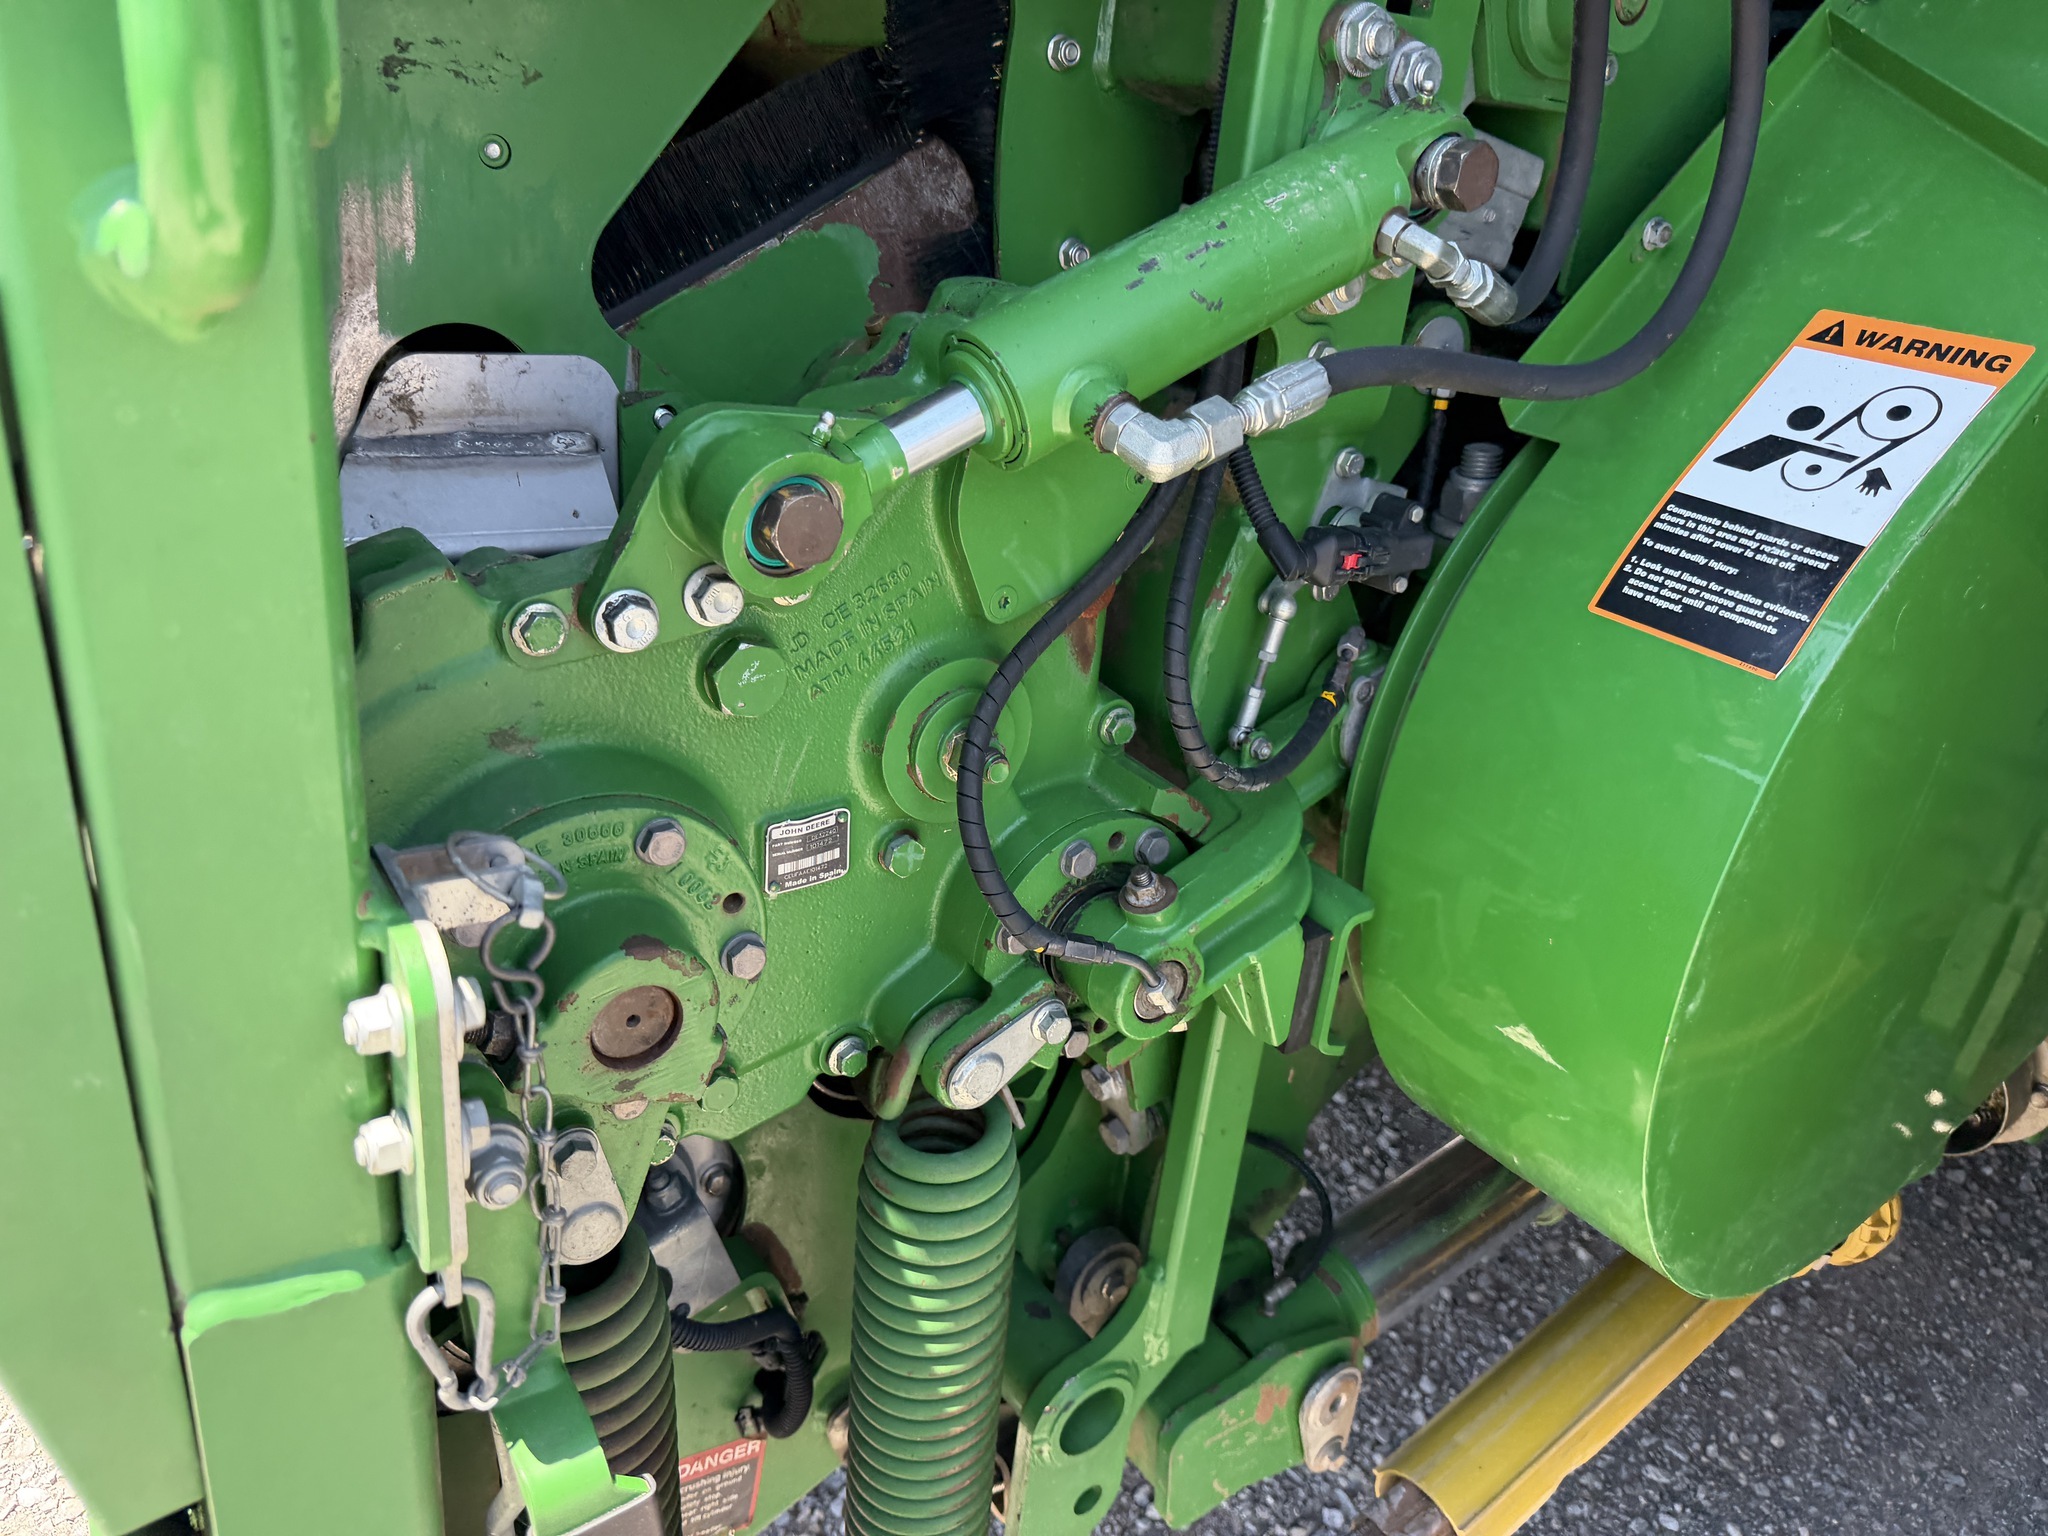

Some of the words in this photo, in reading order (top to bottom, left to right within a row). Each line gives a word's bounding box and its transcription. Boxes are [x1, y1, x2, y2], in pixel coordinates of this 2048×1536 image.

[1855, 329, 2012, 374] WARNING
[1642, 537, 1654, 547] To
[1654, 543, 1680, 555] avoid
[1679, 549, 1709, 566] bodily
[1707, 559, 1739, 575] injury:
[1653, 521, 1690, 537] minutes
[1690, 533, 1714, 544] after
[1712, 540, 1745, 554] power
[1744, 549, 1755, 558] is
[1754, 553, 1779, 566] shut
[1778, 561, 1796, 572] off.
[1659, 513, 1686, 525] doors
[1685, 520, 1697, 528] in
[1697, 523, 1716, 535] this
[1716, 531, 1738, 541] area
[1738, 538, 1760, 549] may
[1759, 544, 1791, 558] rotate
[1791, 554, 1830, 570] several
[1666, 504, 1722, 526] Components
[1722, 521, 1756, 536] behind
[1754, 532, 1790, 547] guards
[1803, 547, 1839, 562] access
[821, 601, 852, 632] CE
[851, 562, 912, 610] 32680
[1622, 564, 1632, 573] 2.
[1633, 567, 1647, 577] Do
[1647, 573, 1665, 583] not
[1664, 579, 1688, 592] open
[1688, 587, 1700, 595] or
[1700, 591, 1736, 608] remove
[1735, 604, 1766, 619] guard
[1766, 614, 1779, 623] or
[1622, 585, 1644, 599] have
[1644, 594, 1683, 613] stopped.
[1628, 578, 1660, 593] access
[1660, 588, 1682, 600] door
[1682, 597, 1705, 609] until
[1704, 604, 1719, 614] all
[1718, 609, 1778, 635] components
[1630, 555, 1638, 564] 1.
[1639, 558, 1663, 572] Look
[1662, 567, 1682, 578] and
[1680, 572, 1708, 587] listen
[1707, 581, 1724, 592] for
[1723, 588, 1763, 606] rotation
[1763, 601, 1810, 623] evidence.
[793, 629, 859, 683] MADE
[856, 613, 882, 639] IN
[881, 570, 943, 621] SPAIN
[808, 663, 852, 701] ATM
[779, 826, 804, 836] JOHN
[805, 818, 831, 830] DEERE
[576, 846, 629, 870] SPAIN
[784, 877, 808, 888] Made
[818, 868, 841, 880] Spain
[678, 1440, 761, 1479] DANGER
